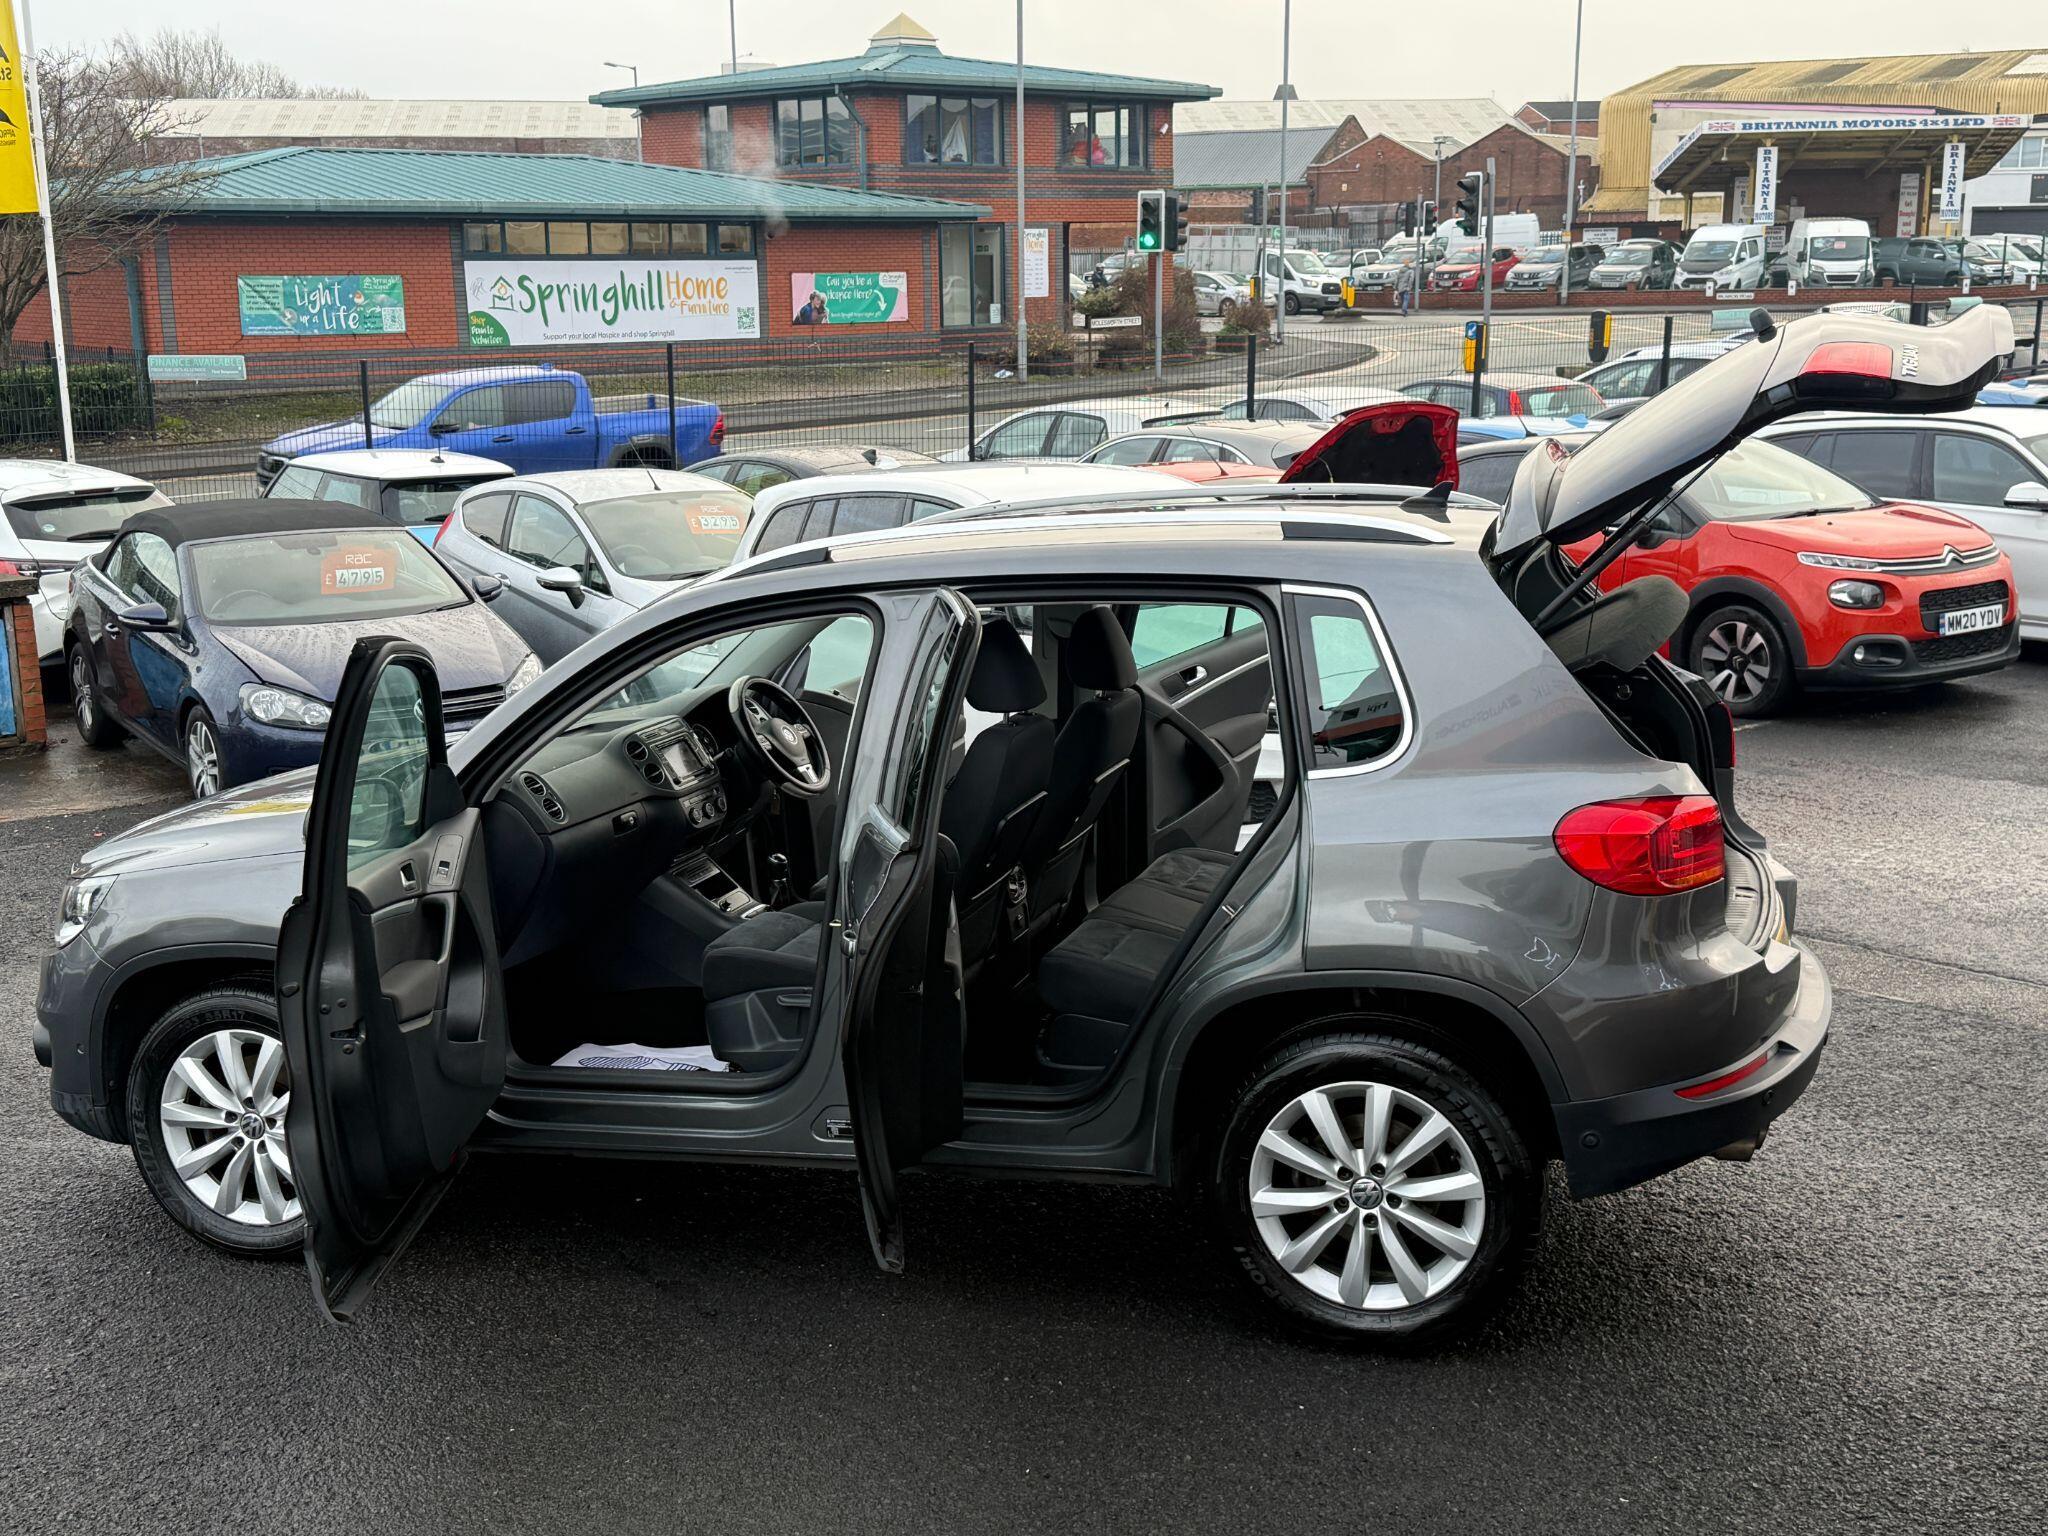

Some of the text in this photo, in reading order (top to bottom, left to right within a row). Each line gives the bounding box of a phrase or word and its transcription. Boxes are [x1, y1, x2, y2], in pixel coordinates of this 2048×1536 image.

[1741, 120, 1838, 131] BRITANNIA
[1842, 119, 1917, 128] MOTORS
[1953, 117, 1985, 127] LTD
[1760, 149, 1772, 211] BRITANNIA
[1945, 144, 1960, 207] BRITANNIA
[1754, 211, 1775, 221] MOTORS
[1941, 208, 1960, 218] MOTORS
[826, 275, 873, 289] Can you be a
[294, 281, 342, 313] Light
[517, 270, 728, 328] Springhill Home
[827, 289, 852, 302] Hospice
[680, 298, 729, 315] Furniture
[322, 305, 359, 331] Life
[1091, 318, 1123, 327] MOLESWORTH
[543, 333, 567, 341] Support
[568, 333, 581, 341] your
[582, 332, 597, 340] local
[598, 331, 620, 340] Hospice
[633, 331, 648, 339] shop
[649, 330, 675, 339] Springhill
[150, 357, 243, 367] FINANCE AVAILABLE
[1901, 343, 1919, 377] TIGUAN
[1947, 607, 2001, 633] MM20 YDV
